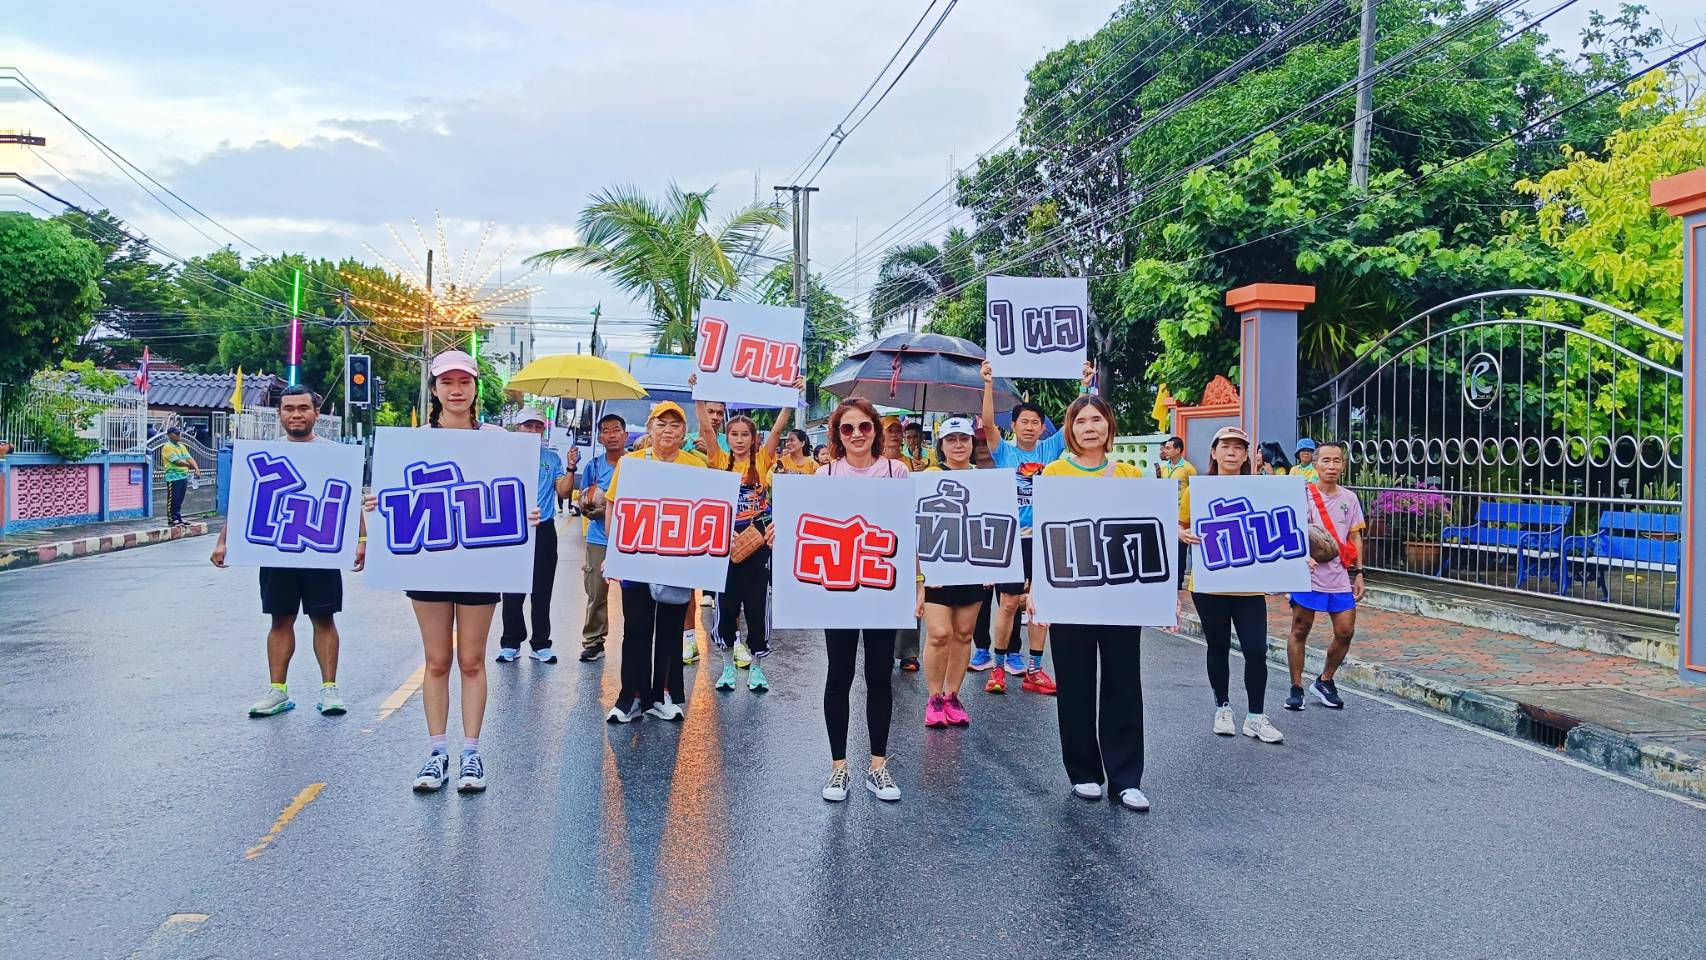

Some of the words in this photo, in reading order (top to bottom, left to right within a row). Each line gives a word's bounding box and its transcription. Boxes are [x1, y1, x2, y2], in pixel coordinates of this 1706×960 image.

[698, 317, 728, 372] 1
[731, 334, 800, 387] คน
[989, 300, 1015, 355] 1
[1022, 306, 1085, 354] ผล
[245, 452, 351, 553] ไม่
[378, 460, 528, 555] ทับ
[615, 498, 733, 557] ทอด
[916, 479, 1017, 568] ทิ้ง
[1195, 497, 1306, 571] กัน
[794, 513, 897, 591] สะ
[1041, 517, 1170, 588] แก
